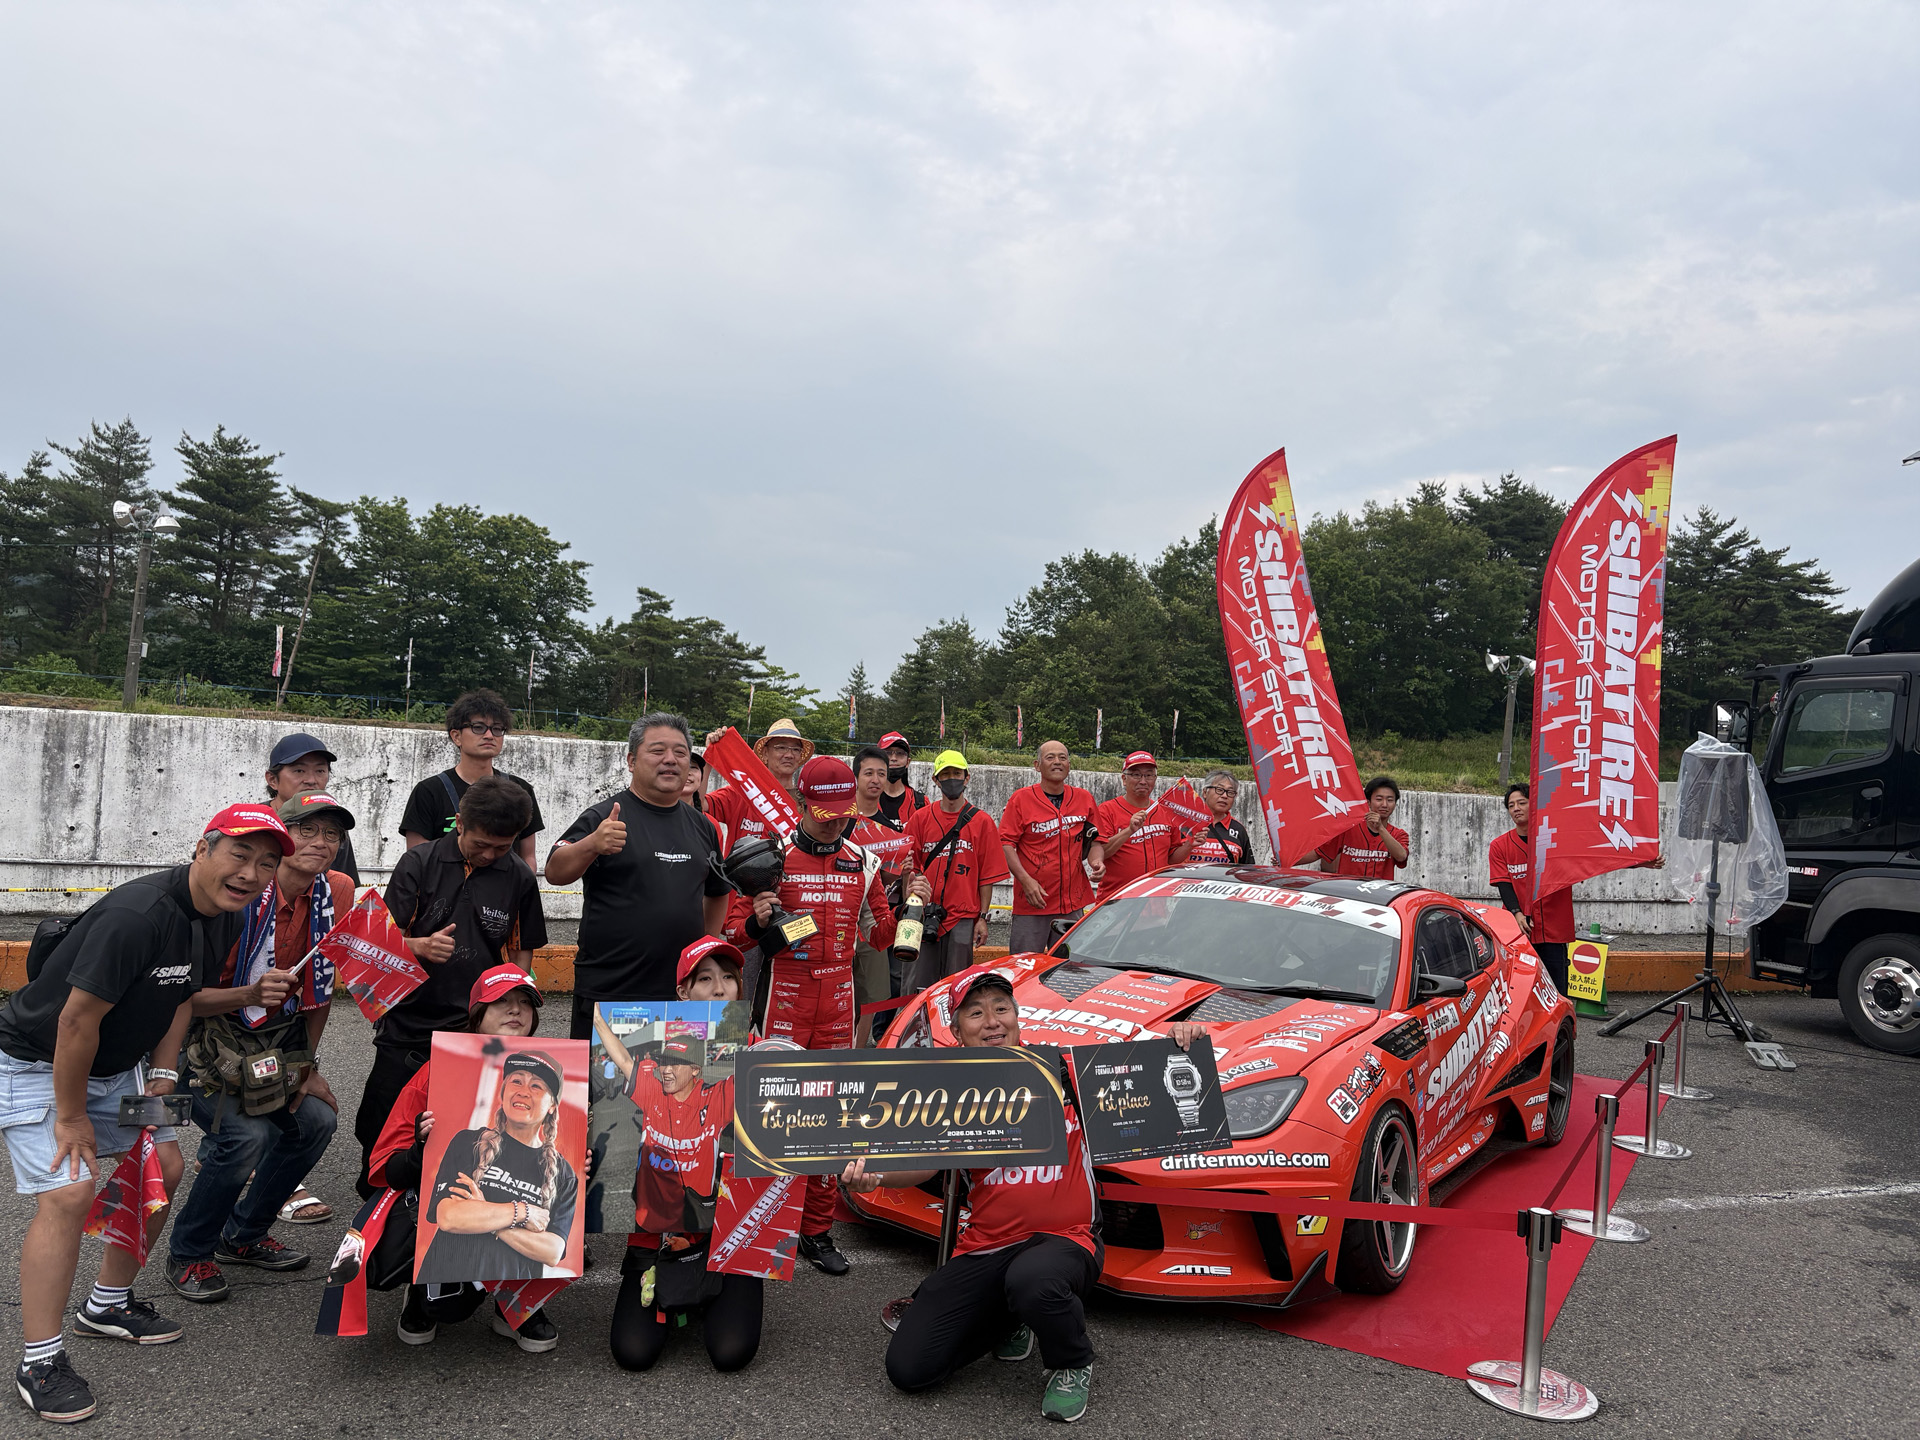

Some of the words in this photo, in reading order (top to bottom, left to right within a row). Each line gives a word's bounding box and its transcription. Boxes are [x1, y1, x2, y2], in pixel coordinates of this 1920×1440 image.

[1576, 544, 1599, 665] MOTOR
[1237, 555, 1271, 663] MOTOR
[1261, 668, 1299, 775] SPORT
[1254, 529, 1341, 790] SHIBATIRE
[1599, 519, 1641, 821] SHIBATIRE
[1571, 675, 1593, 796] SPORT
[813, 782, 852, 791] SHIBATIRE
[1228, 828, 1239, 839] D1
[791, 874, 850, 884] SHIBATA
[1804, 867, 1818, 876] DRIFT
[800, 892, 843, 902] MOTUL
[1174, 882, 1241, 896] FORMULA
[1244, 887, 1301, 905] DRIFT
[1301, 900, 1334, 911] JAPAN
[337, 933, 409, 973] SHIBATIRE
[346, 949, 371, 964] RACING
[374, 961, 393, 975] TEAM
[1128, 982, 1169, 994] Lenovo
[1568, 982, 1577, 991] No
[1579, 984, 1599, 996] Entry
[1569, 973, 1597, 986] 進入禁止
[1096, 988, 1169, 1007] AliExpress
[773, 1021, 793, 1030] HKS
[1425, 976, 1502, 1112] SHIBATIRE
[1095, 1067, 1114, 1075] FORMULA
[1114, 1065, 1129, 1074] DRIFT
[1130, 1064, 1143, 1072] JAPAN
[759, 1083, 800, 1097] FORMULA
[802, 1082, 833, 1097] DRIFT
[837, 1081, 865, 1095] JAPAN
[1437, 1064, 1478, 1126] RACING
[1524, 1093, 1548, 1106] AME
[837, 1081, 1032, 1136] ¥500,000
[1097, 1087, 1118, 1112] 1st
[1118, 1093, 1151, 1118] place
[760, 1099, 785, 1129] 1st
[785, 1108, 828, 1137] place
[649, 1152, 700, 1173] MOTUL
[1161, 1150, 1330, 1171] driftermovie.com
[984, 1165, 1064, 1186] MOTUL
[1158, 1264, 1232, 1275] AME
